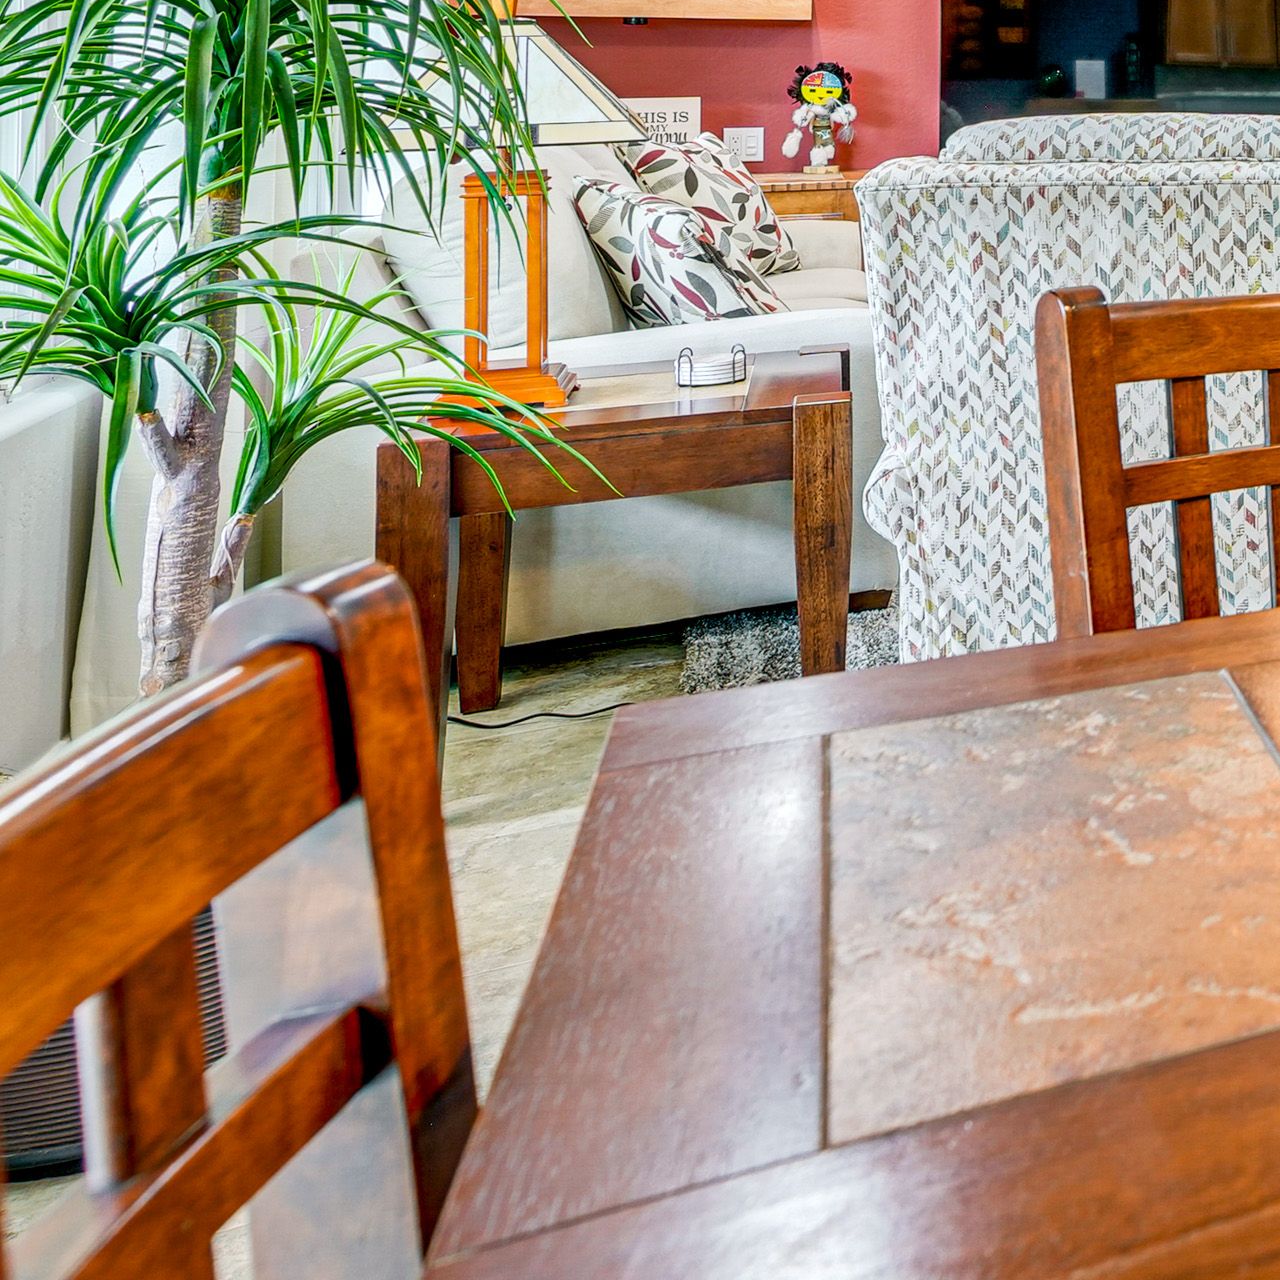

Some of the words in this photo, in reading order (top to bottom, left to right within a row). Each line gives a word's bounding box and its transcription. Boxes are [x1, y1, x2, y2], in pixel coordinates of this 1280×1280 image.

[637, 111, 667, 123] HIS
[673, 111, 689, 123] IS
[650, 124, 669, 133] MY
